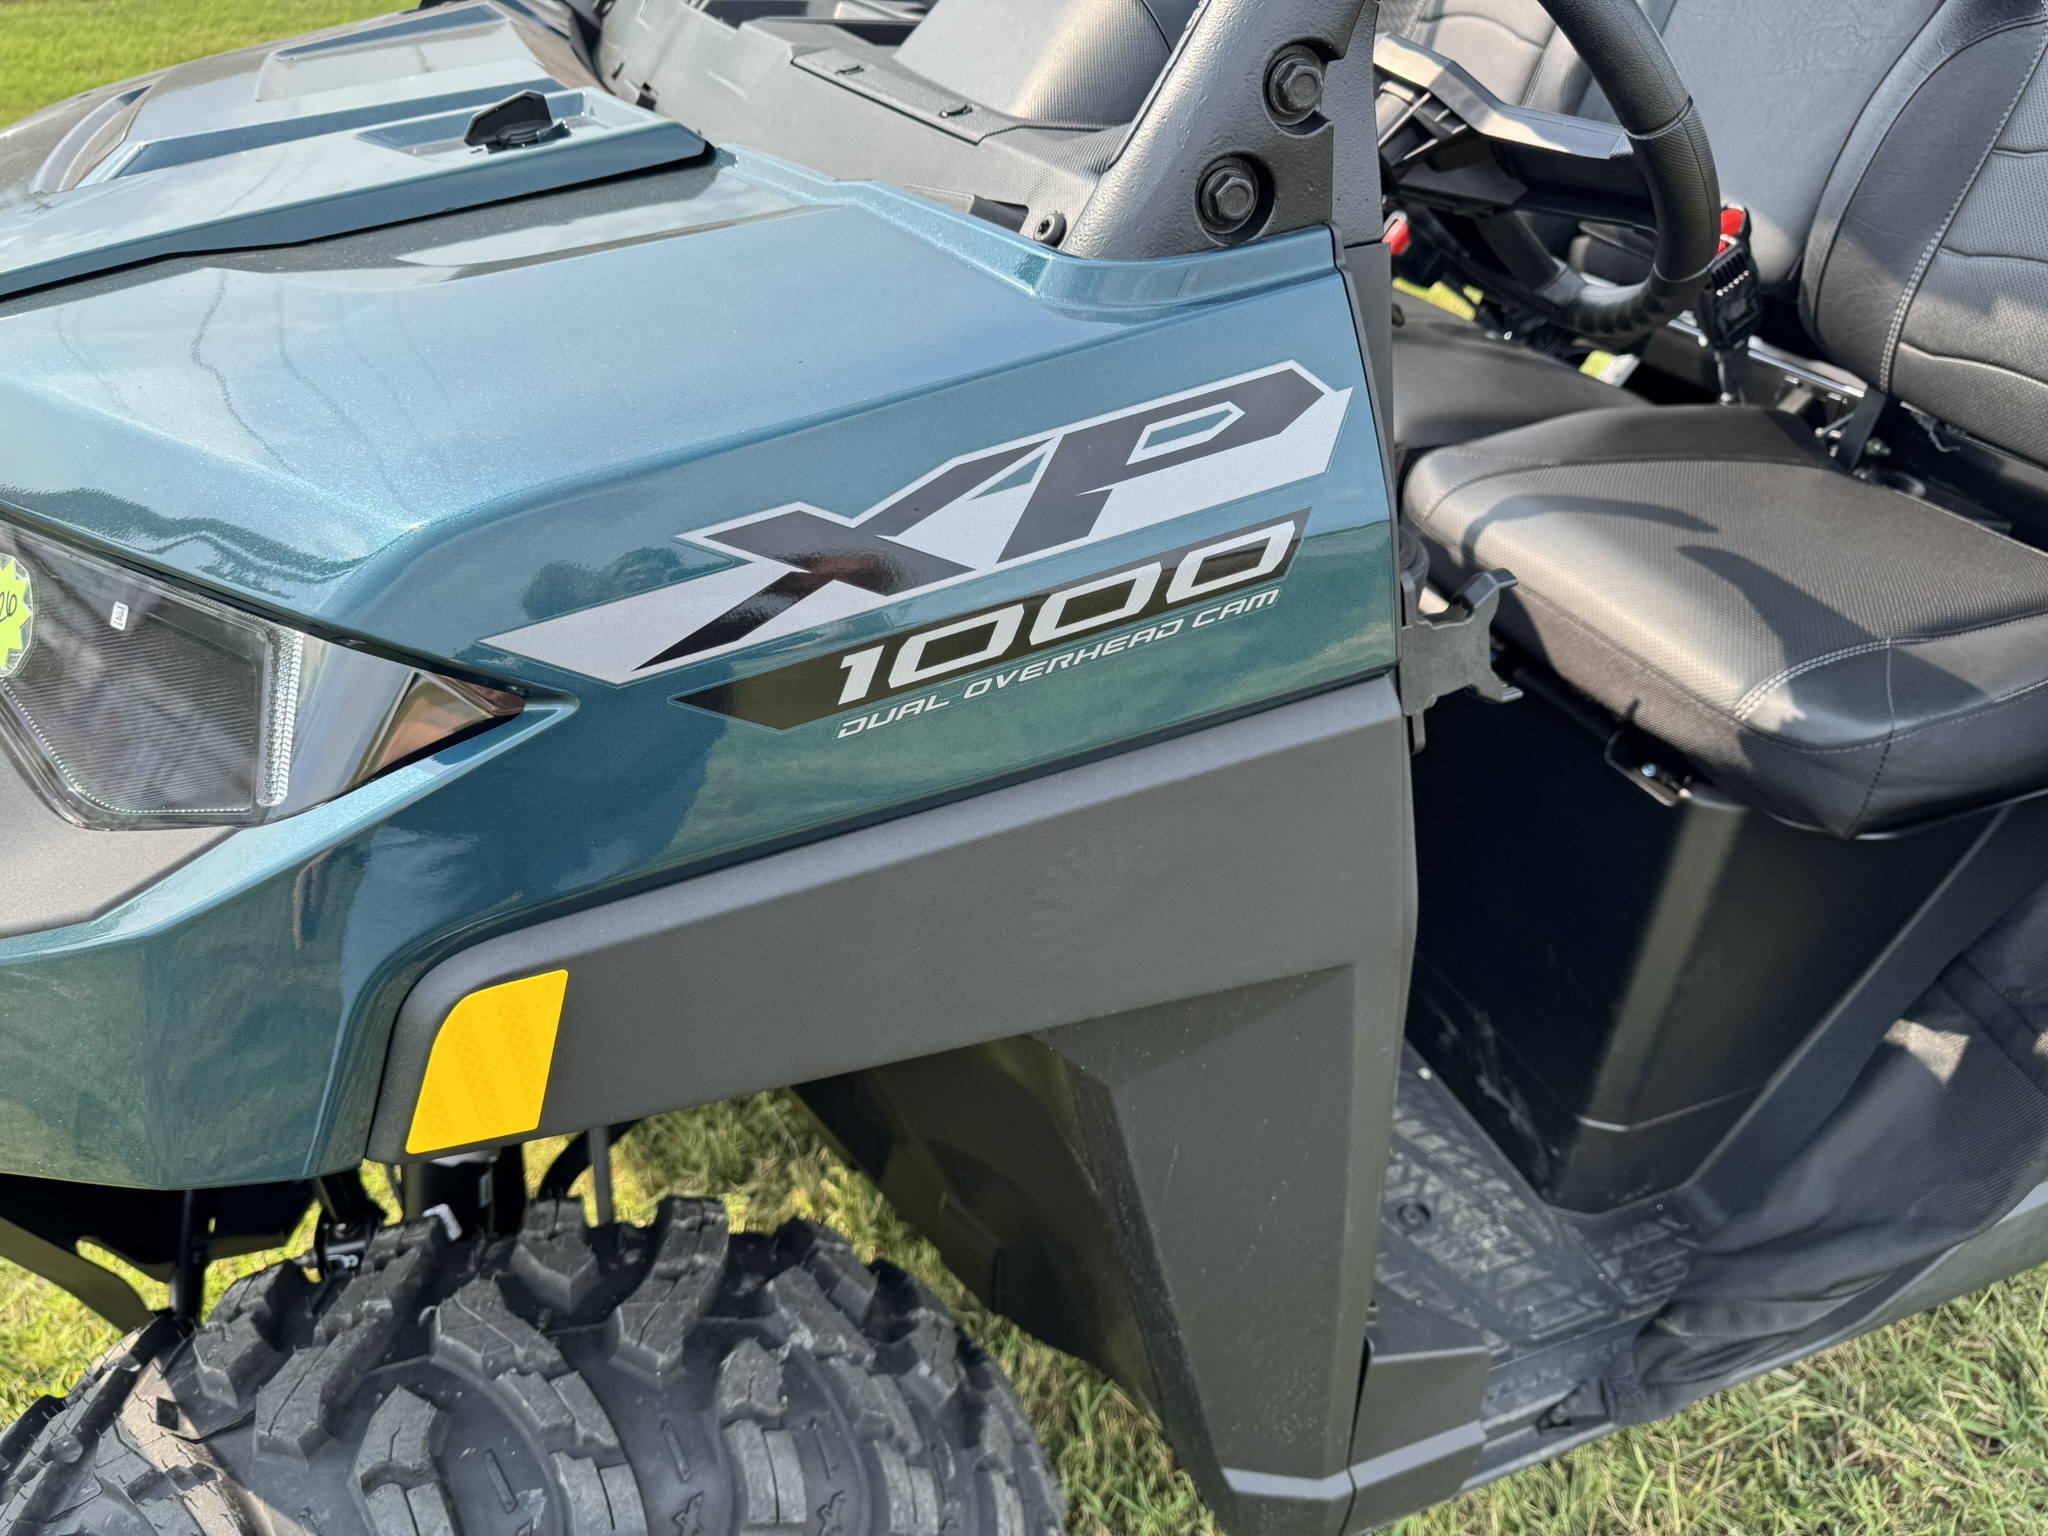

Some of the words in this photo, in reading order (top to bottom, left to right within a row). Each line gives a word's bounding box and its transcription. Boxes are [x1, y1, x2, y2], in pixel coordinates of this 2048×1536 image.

[632, 368, 1327, 672] XP
[838, 520, 1295, 705] 1000
[837, 695, 950, 739] DUAL
[963, 618, 1184, 700] OVERHEAD
[1191, 588, 1280, 629] CAM
